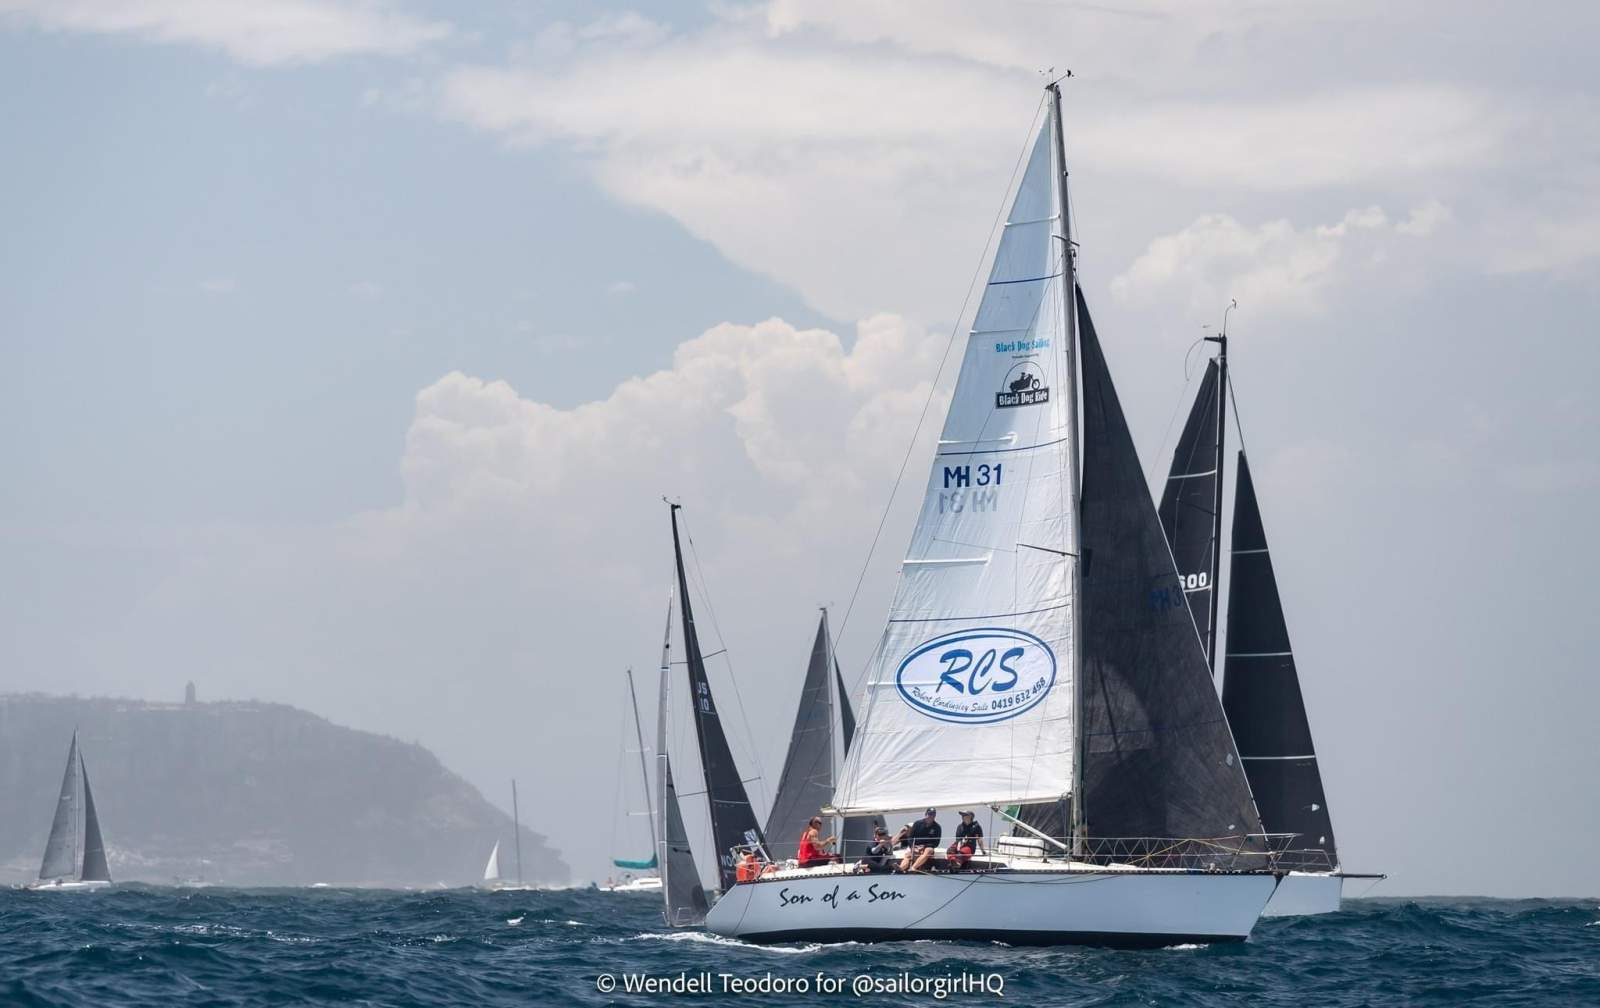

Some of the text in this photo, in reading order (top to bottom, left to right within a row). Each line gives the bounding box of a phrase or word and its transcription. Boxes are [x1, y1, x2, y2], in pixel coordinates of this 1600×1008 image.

[995, 341, 1015, 352] Black
[1017, 340, 1030, 351] Dog
[999, 392, 1019, 405] Black
[1021, 392, 1034, 404] Dog
[943, 463, 1002, 488] MH 31
[935, 647, 1025, 696] RCS
[991, 696, 1014, 710] 0419
[1015, 688, 1031, 705] 632
[777, 883, 907, 909] Son of a Son
